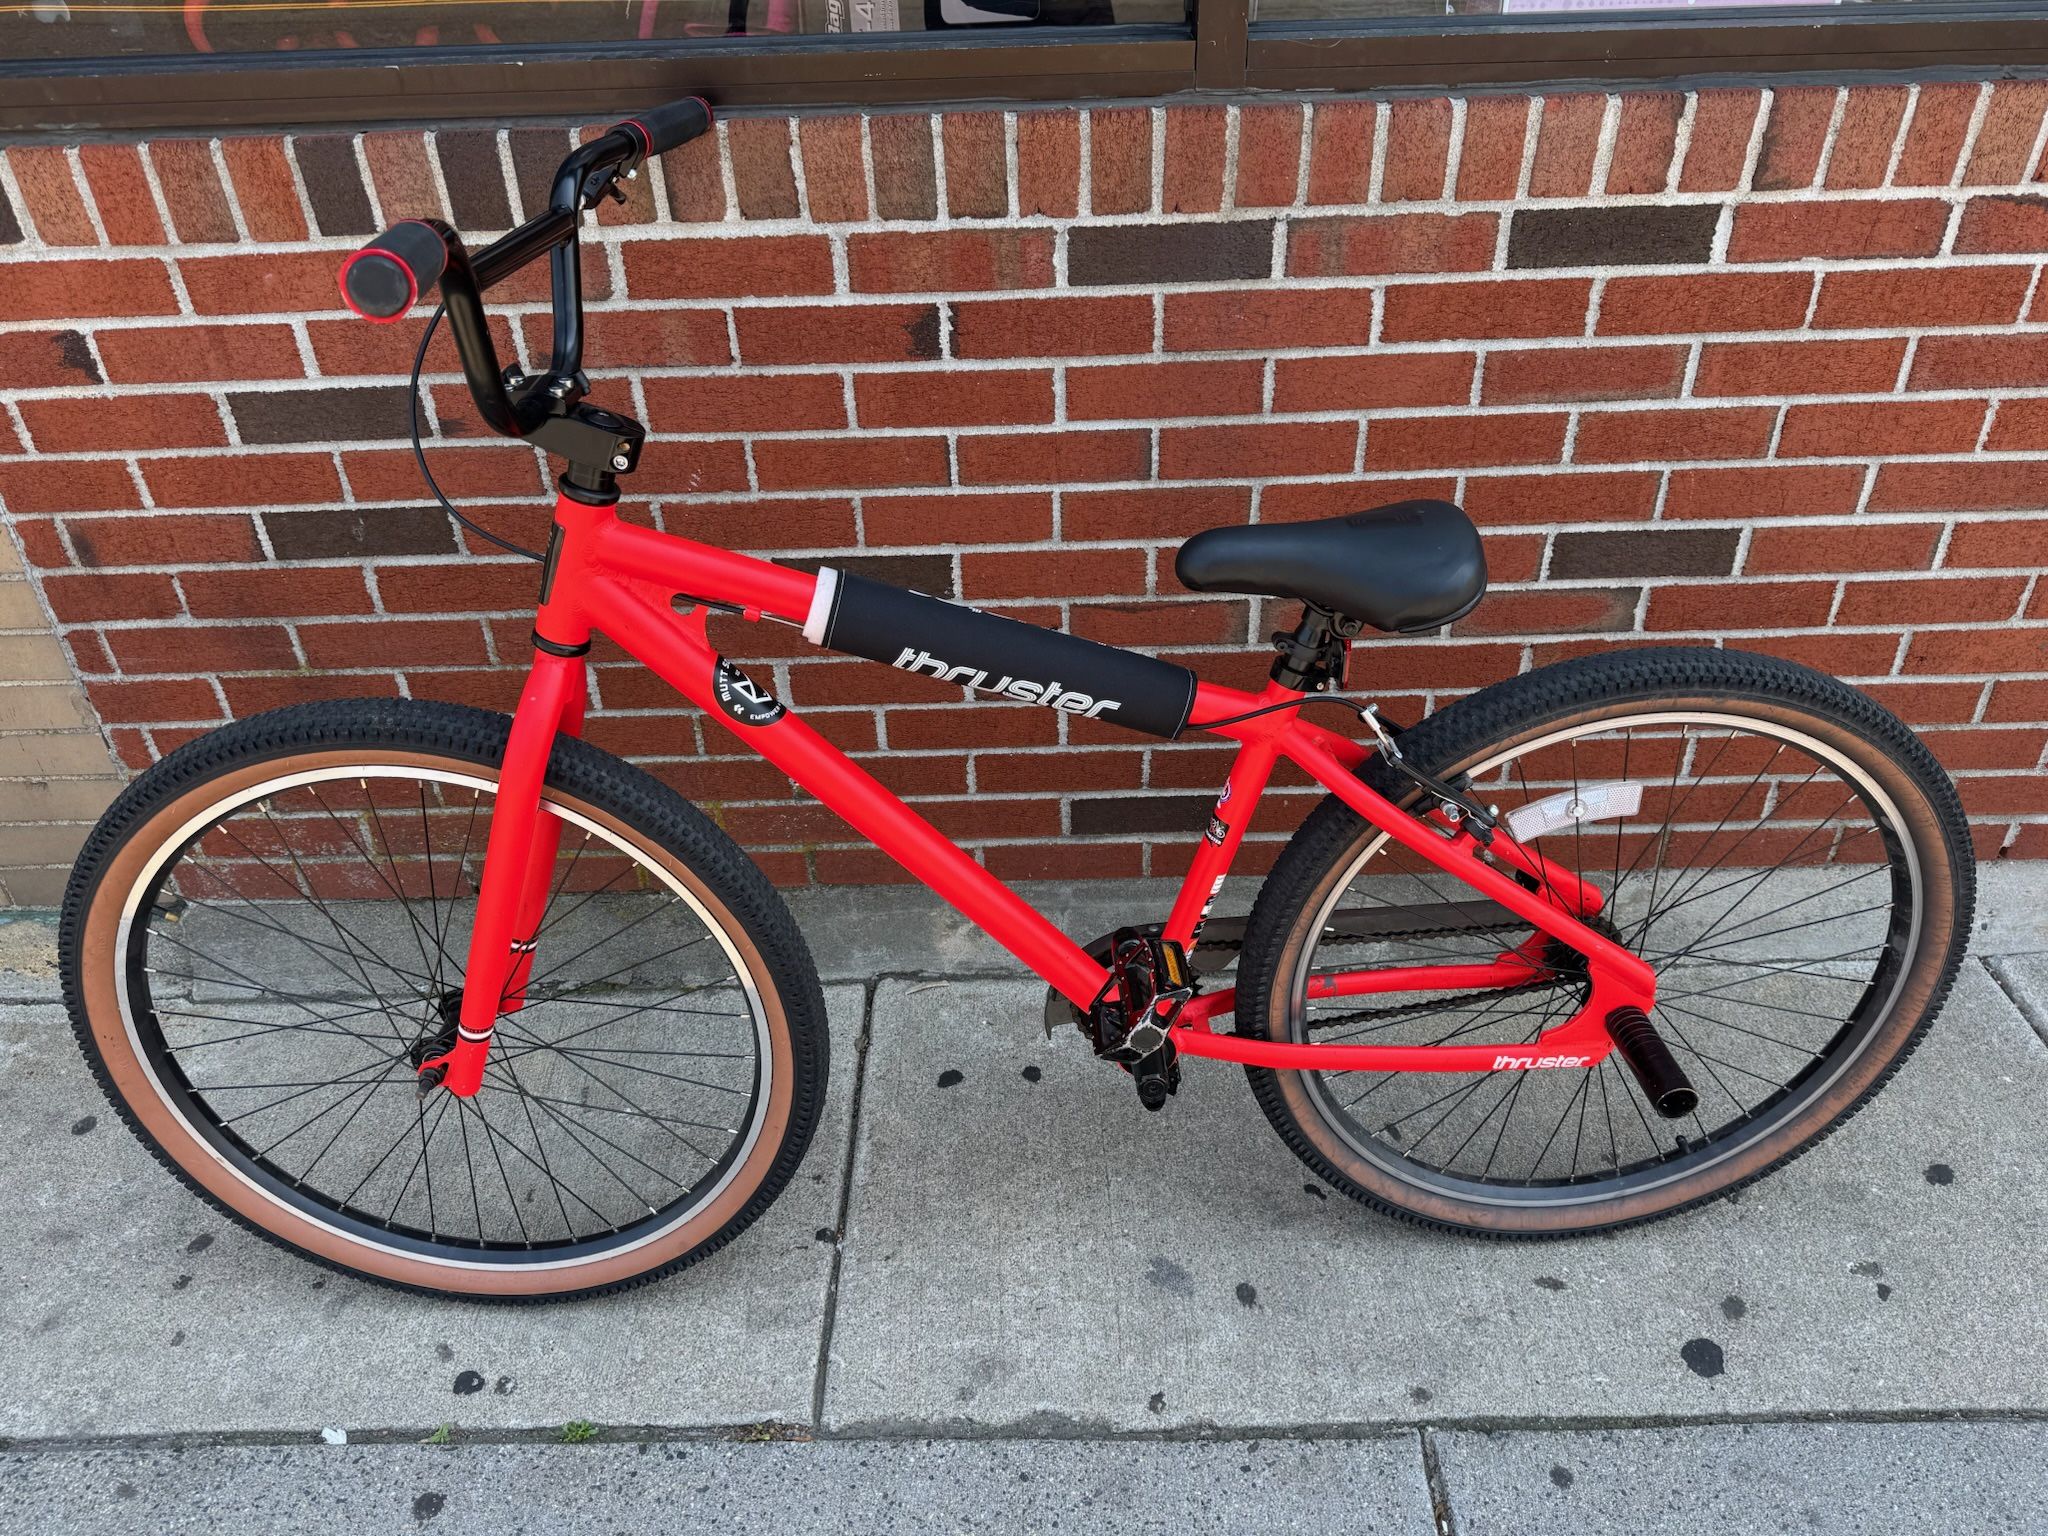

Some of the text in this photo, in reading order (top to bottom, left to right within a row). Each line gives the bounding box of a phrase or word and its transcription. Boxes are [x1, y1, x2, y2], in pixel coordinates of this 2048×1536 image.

[719, 669, 731, 701] MUTT
[892, 647, 1121, 720] thruster
[1492, 1055, 1590, 1069] thruster
